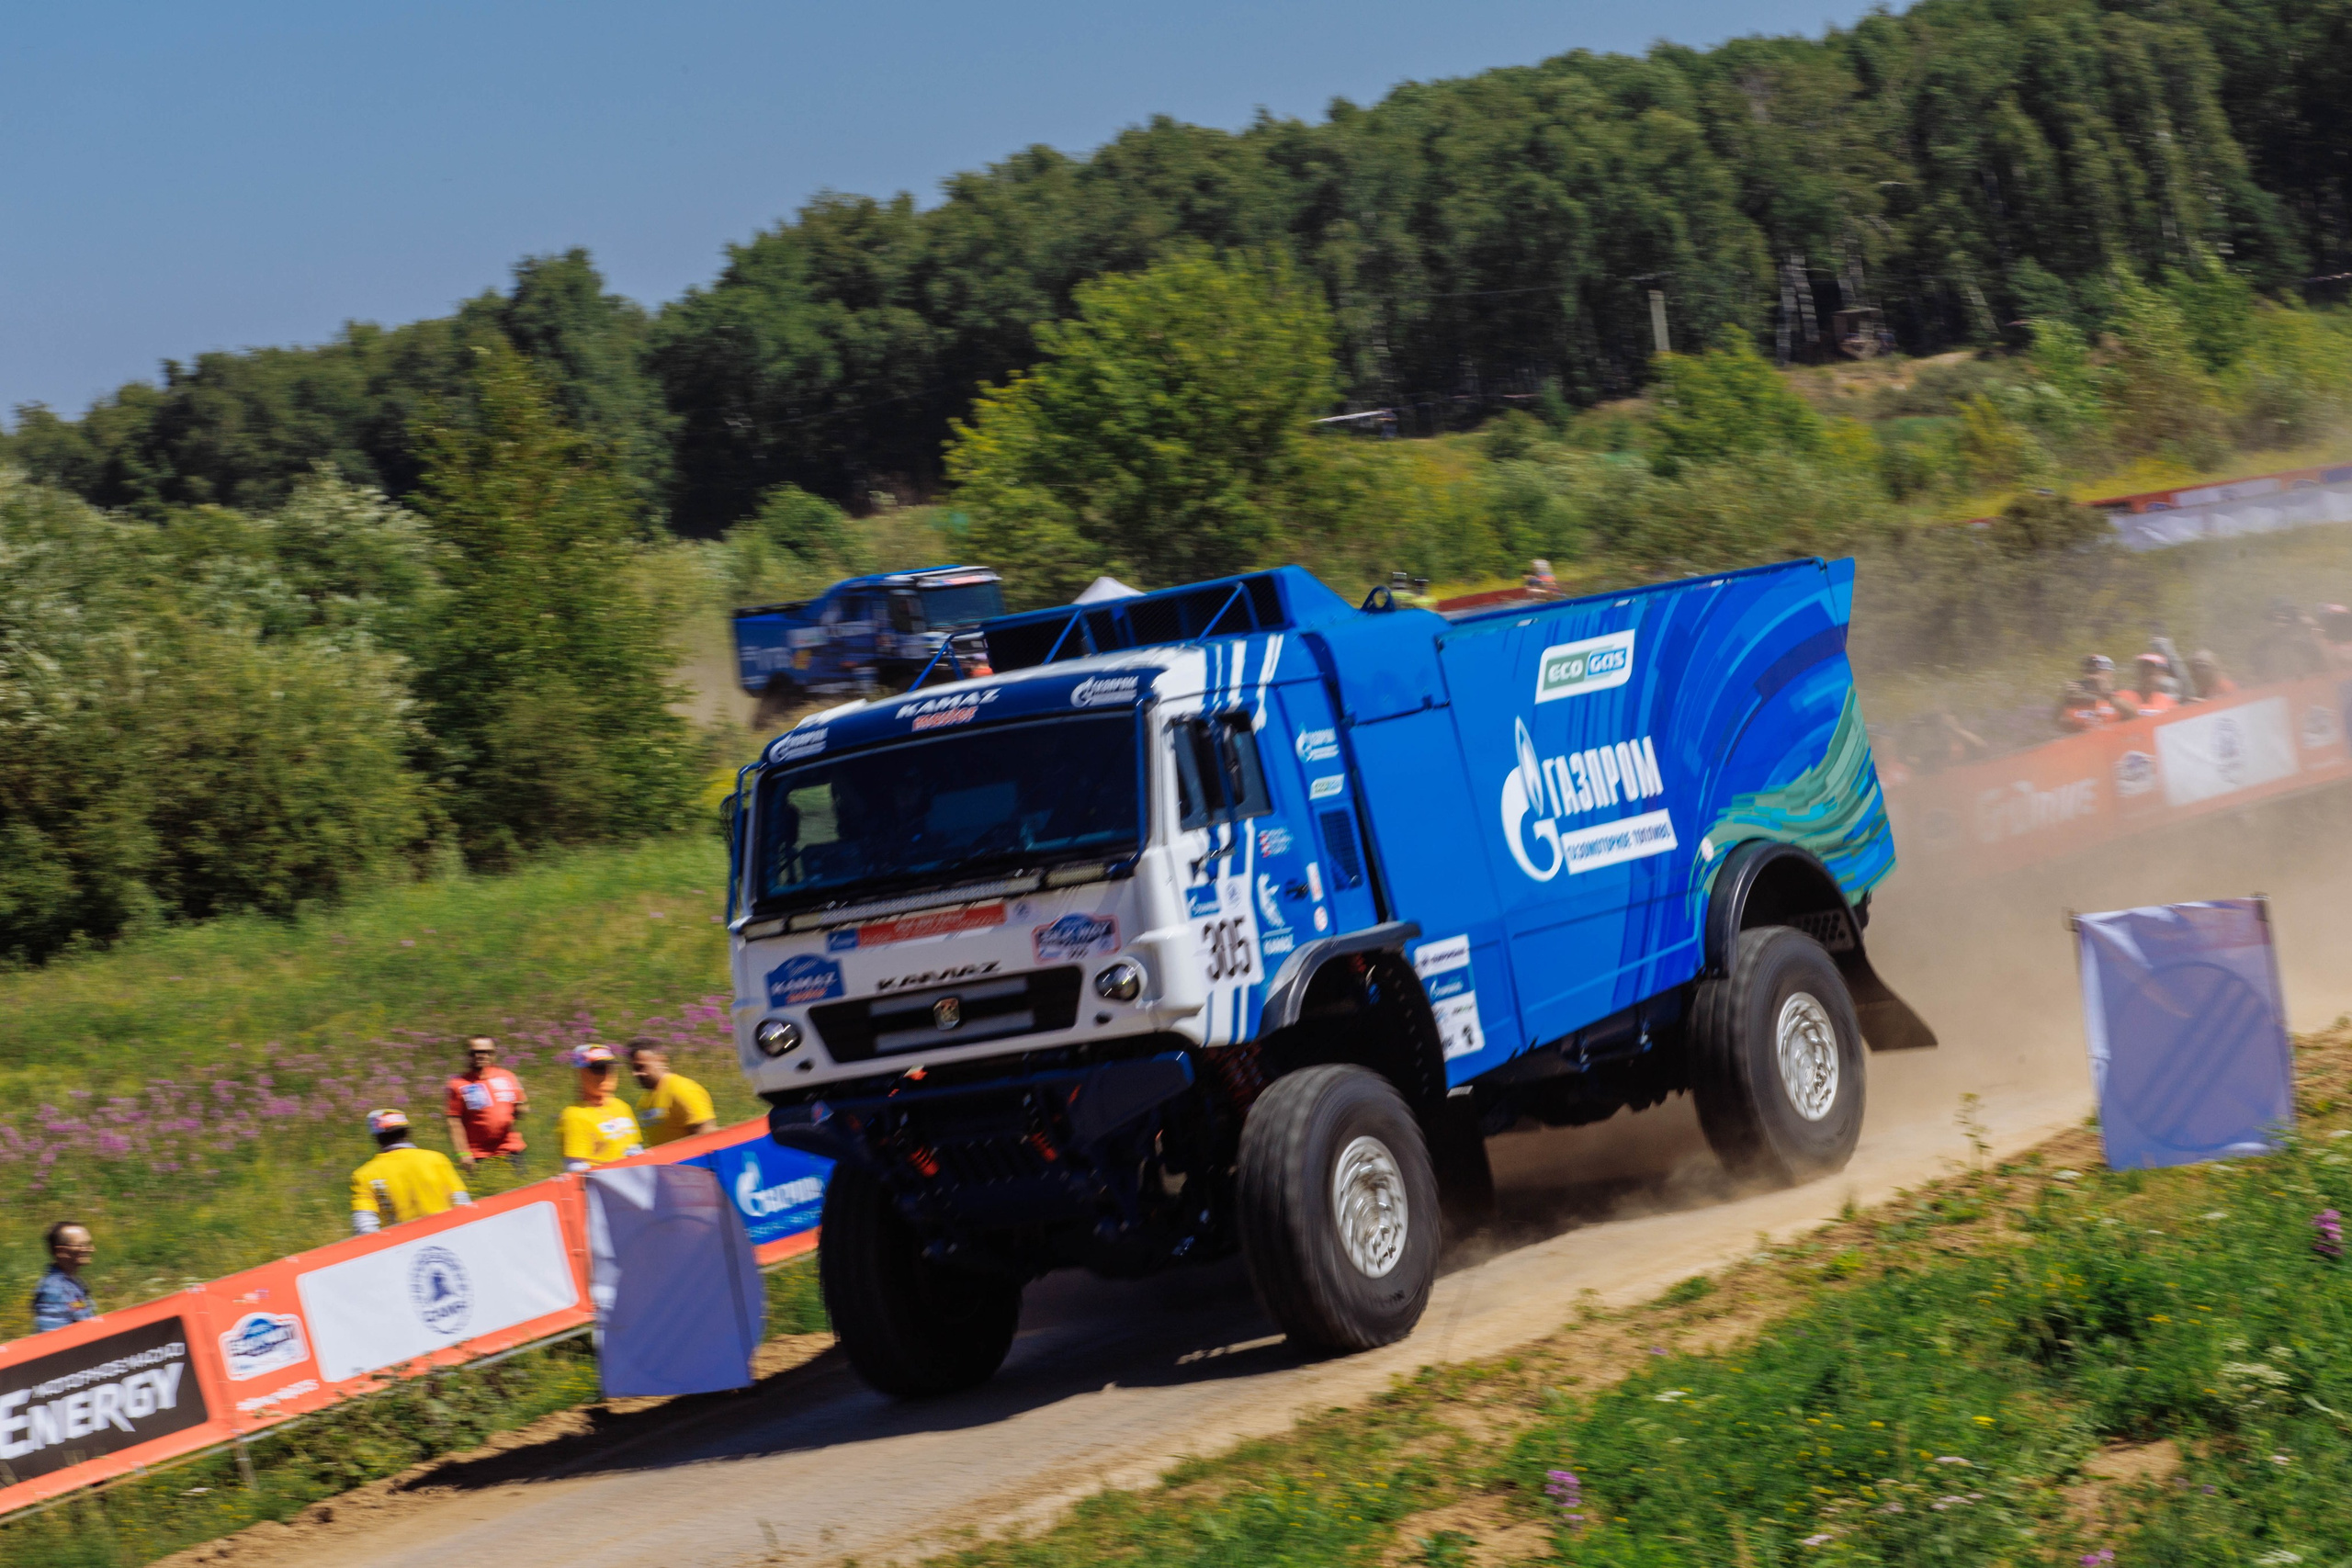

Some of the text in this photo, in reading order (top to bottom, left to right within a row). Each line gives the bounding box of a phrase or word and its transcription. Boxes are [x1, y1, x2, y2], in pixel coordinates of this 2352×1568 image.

[895, 687, 1002, 719] KAMAZ
[1542, 735, 1664, 818] ГАЗПРОМ
[1202, 915, 1253, 981] 305
[0, 1362, 186, 1460] ENERGY
